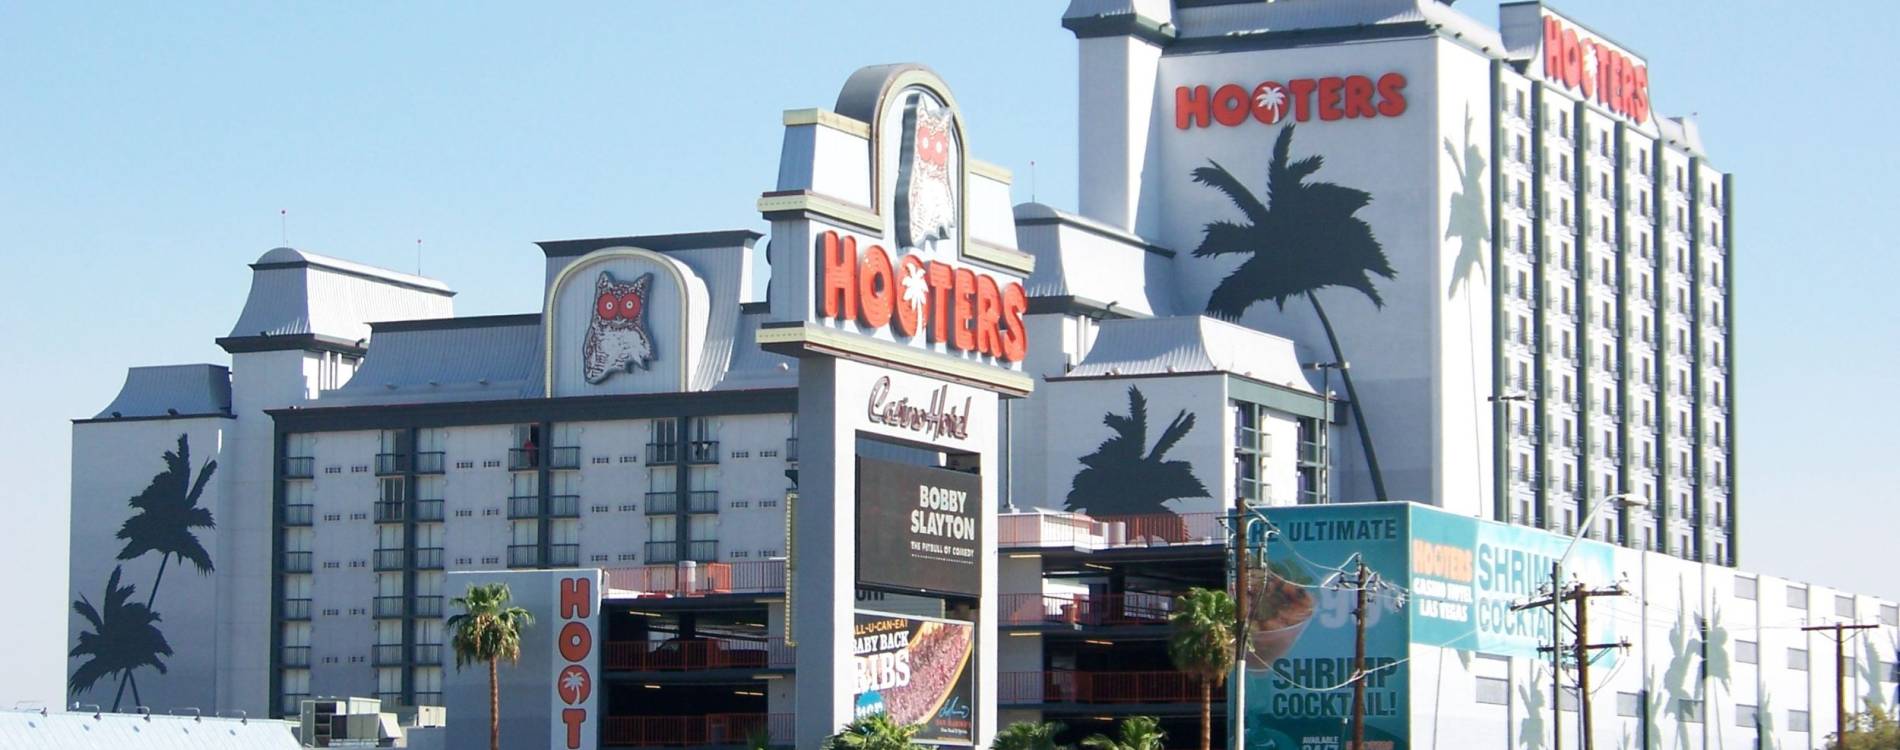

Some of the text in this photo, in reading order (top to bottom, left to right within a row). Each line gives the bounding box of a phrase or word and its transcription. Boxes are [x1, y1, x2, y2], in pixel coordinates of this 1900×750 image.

[1543, 15, 1648, 125] HOOTERS
[1175, 72, 1407, 130] HOOTERS
[816, 230, 1028, 362] HOOTERS
[920, 485, 967, 513] BOBBY
[910, 509, 975, 540] SLAYTON
[1289, 519, 1397, 542] ULTIMATE
[910, 541, 974, 558] THE PITBULL OF COMEDY
[1479, 543, 1552, 594] SHRIM
[1419, 599, 1469, 622] LAS VEGAS
[1478, 597, 1551, 642] COCKTAI
[853, 630, 910, 654] BABY BACK
[1302, 736, 1339, 744] AVAILABLE
